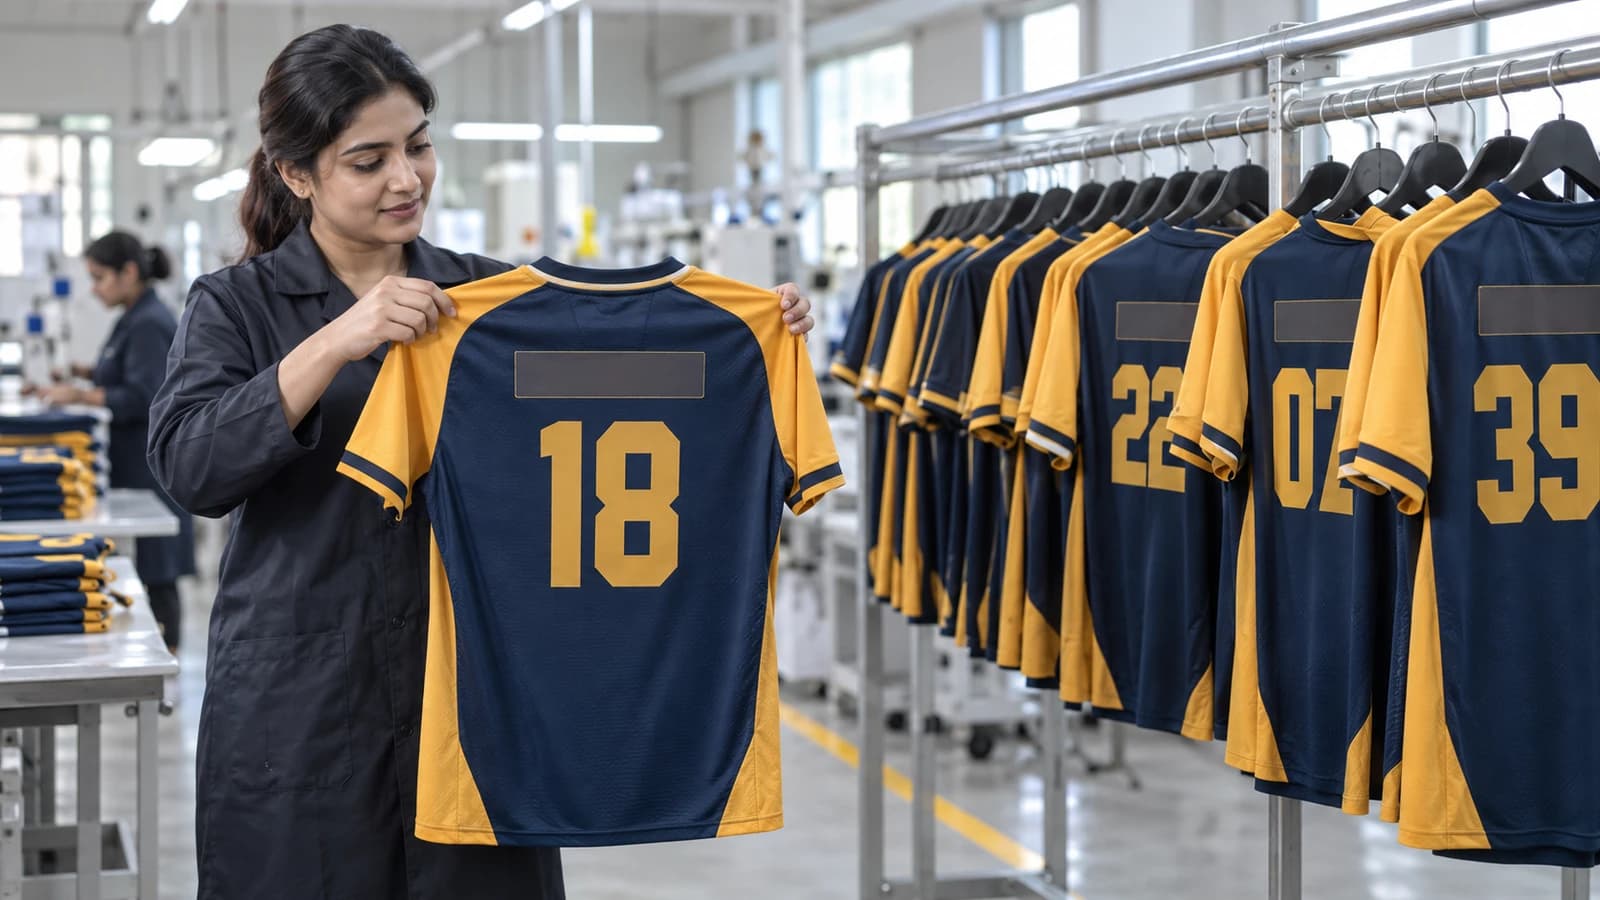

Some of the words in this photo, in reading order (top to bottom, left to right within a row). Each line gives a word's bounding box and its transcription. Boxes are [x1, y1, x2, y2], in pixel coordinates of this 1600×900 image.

[540, 421, 680, 587] 18
[1111, 364, 1186, 493] 22
[1473, 363, 1600, 524] 39
